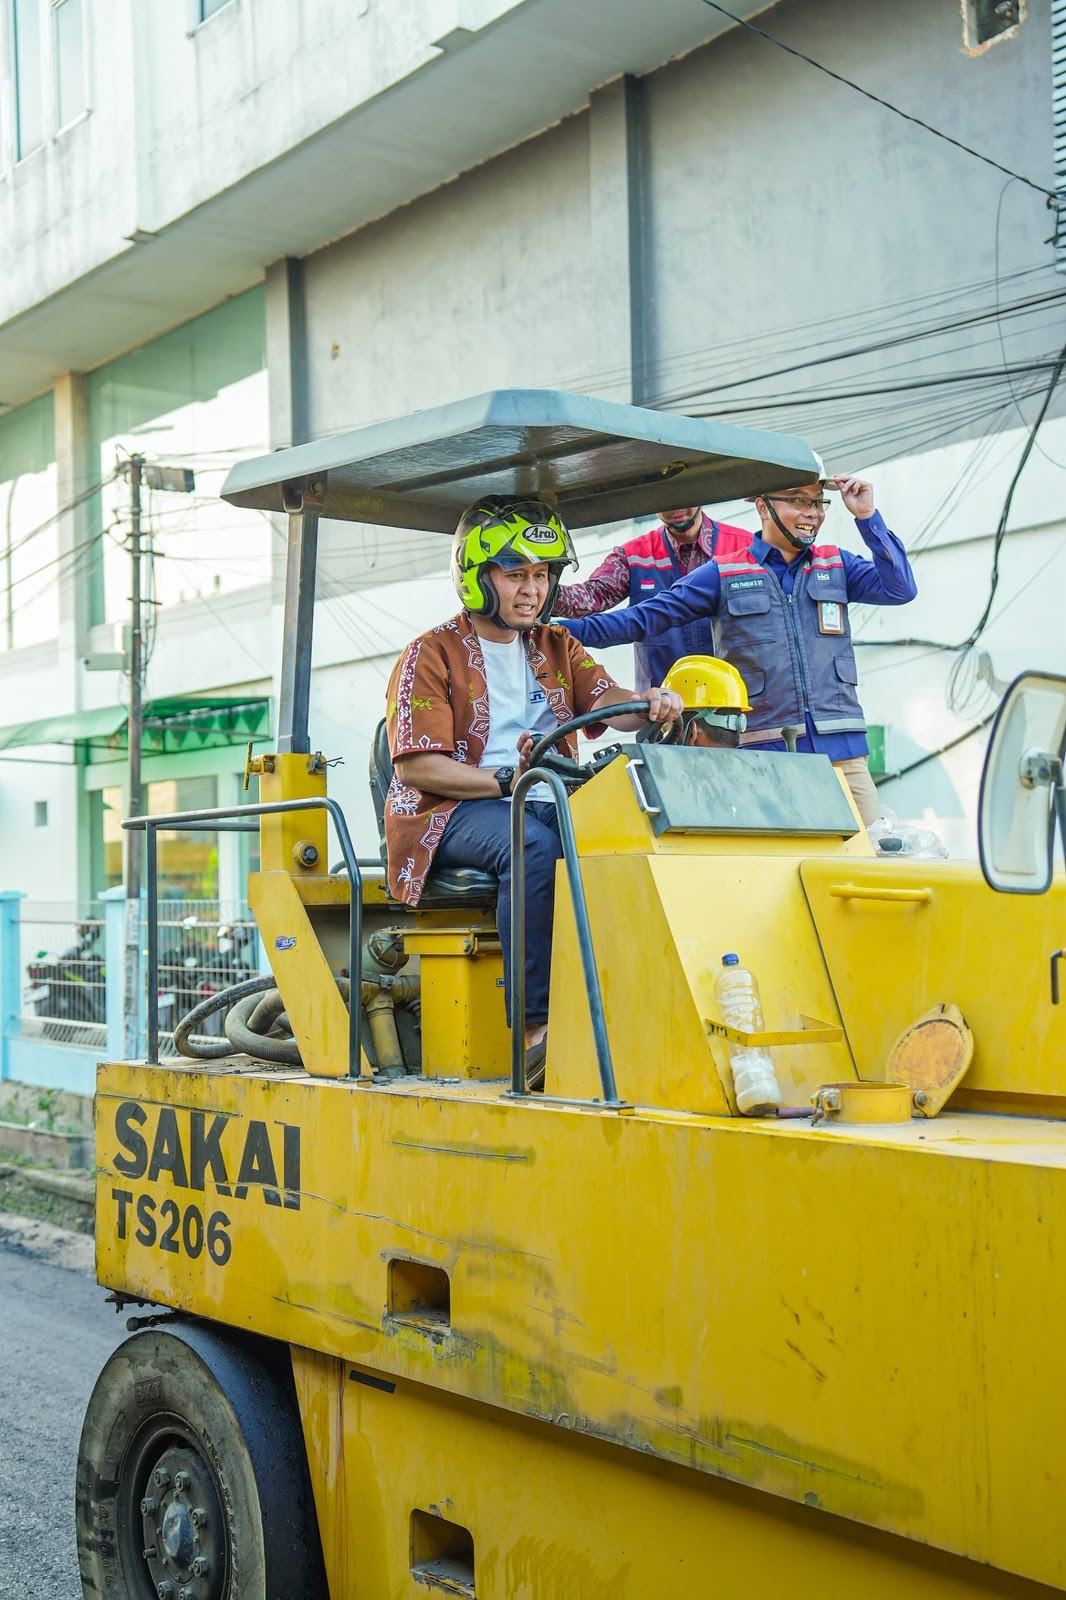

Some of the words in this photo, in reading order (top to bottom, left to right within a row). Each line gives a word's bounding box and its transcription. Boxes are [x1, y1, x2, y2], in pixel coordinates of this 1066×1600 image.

[526, 527, 555, 539] Arai
[112, 1101, 301, 1211] SAKAI
[111, 1188, 232, 1267] TS206
